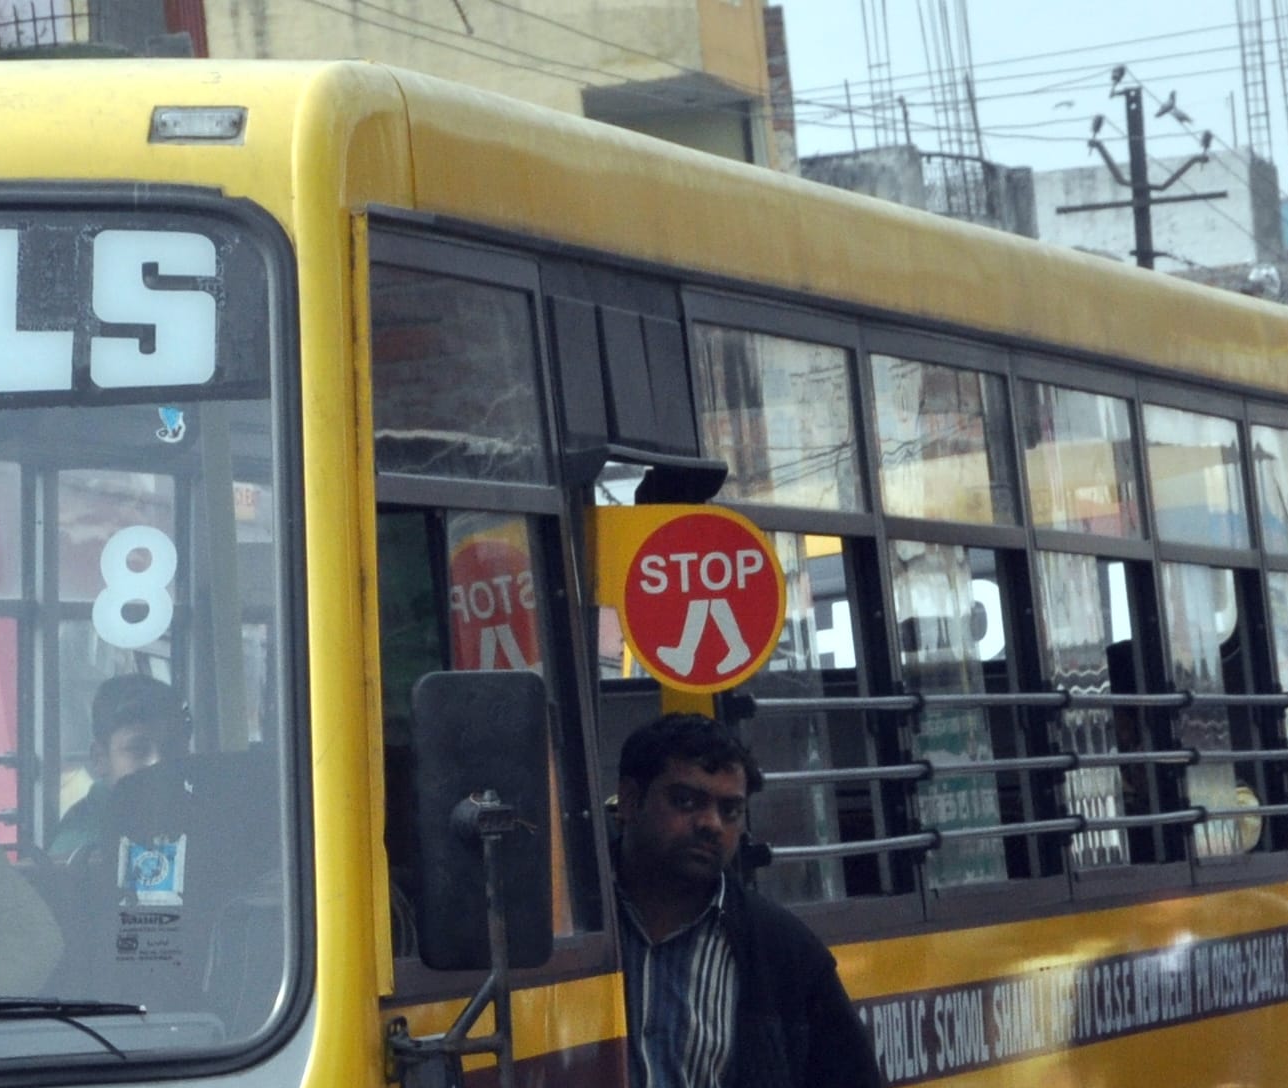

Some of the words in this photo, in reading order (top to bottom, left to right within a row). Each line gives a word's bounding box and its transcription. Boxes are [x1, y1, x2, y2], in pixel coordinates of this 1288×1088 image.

[92, 525, 178, 649] 8
[639, 549, 765, 594] STOP
[873, 999, 929, 1083] PUBLIC
[934, 988, 990, 1073] SCHOOL
